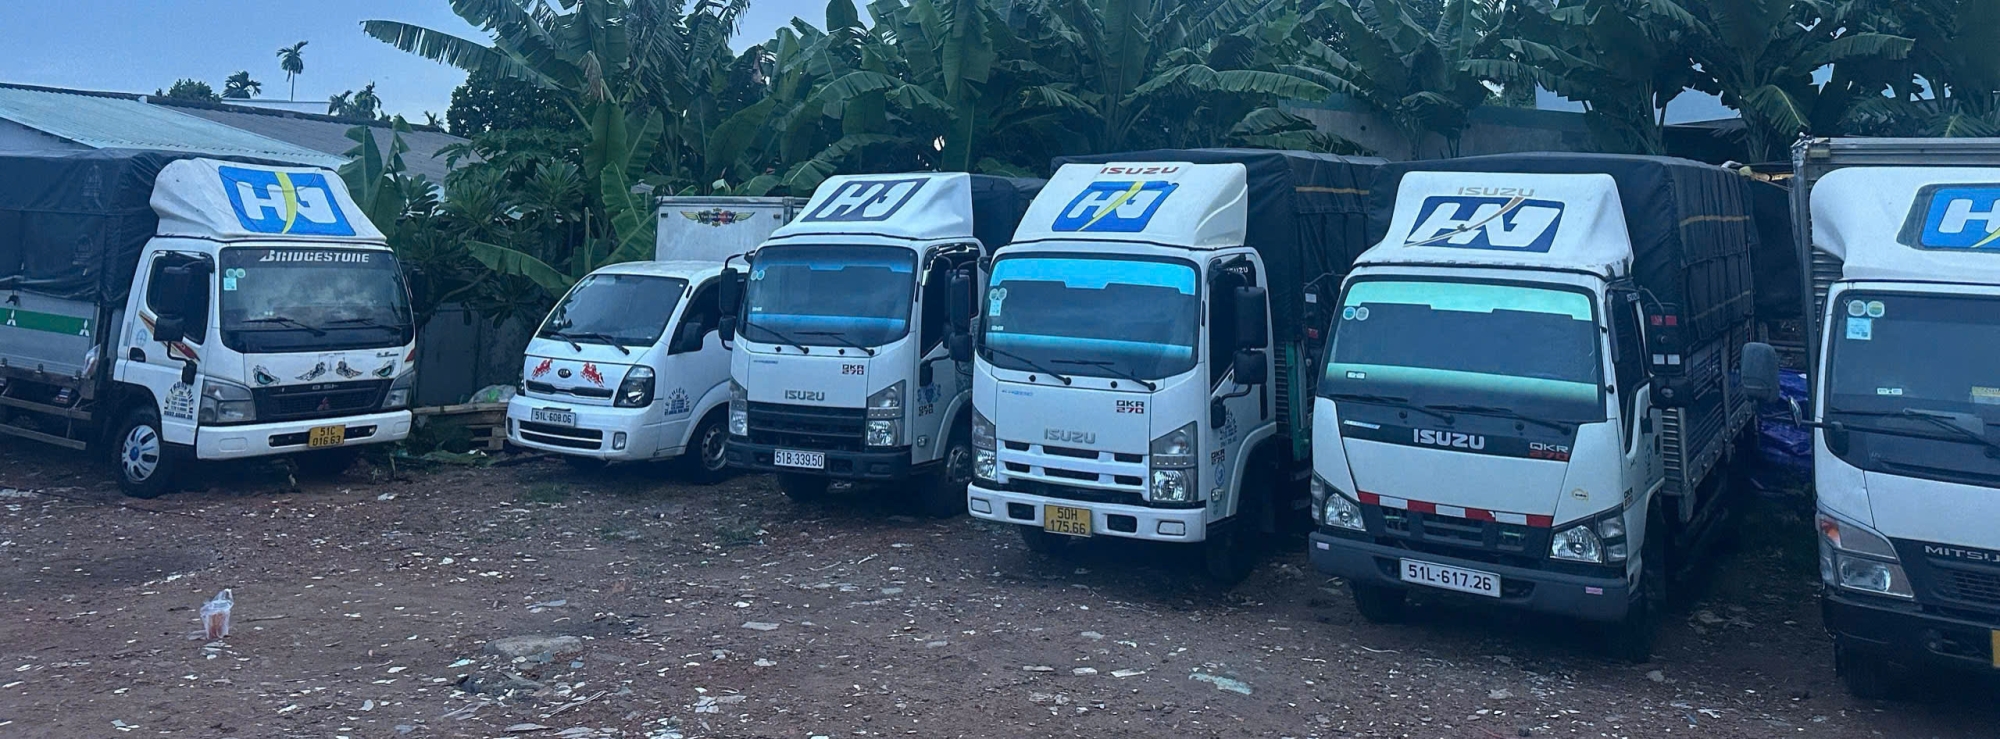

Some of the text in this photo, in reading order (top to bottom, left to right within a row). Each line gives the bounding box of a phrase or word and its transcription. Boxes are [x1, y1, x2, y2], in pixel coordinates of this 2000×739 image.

[1099, 166, 1180, 175] ISUZU
[1457, 186, 1535, 197] ISUZU
[259, 250, 370, 263] BRIDGESTONE
[784, 389, 825, 401] ISUZU
[1116, 399, 1144, 407] QKR
[320, 426, 335, 436] 51C
[1044, 428, 1096, 444] ISUZU
[1413, 428, 1485, 450] ISUZU
[1530, 442, 1569, 453] QKR
[776, 451, 823, 467] 51B-339.50
[1529, 450, 1570, 461] 270
[1057, 507, 1078, 520] 50H
[1050, 519, 1086, 535] 175.66
[1408, 564, 1492, 591] 51L-617.26
